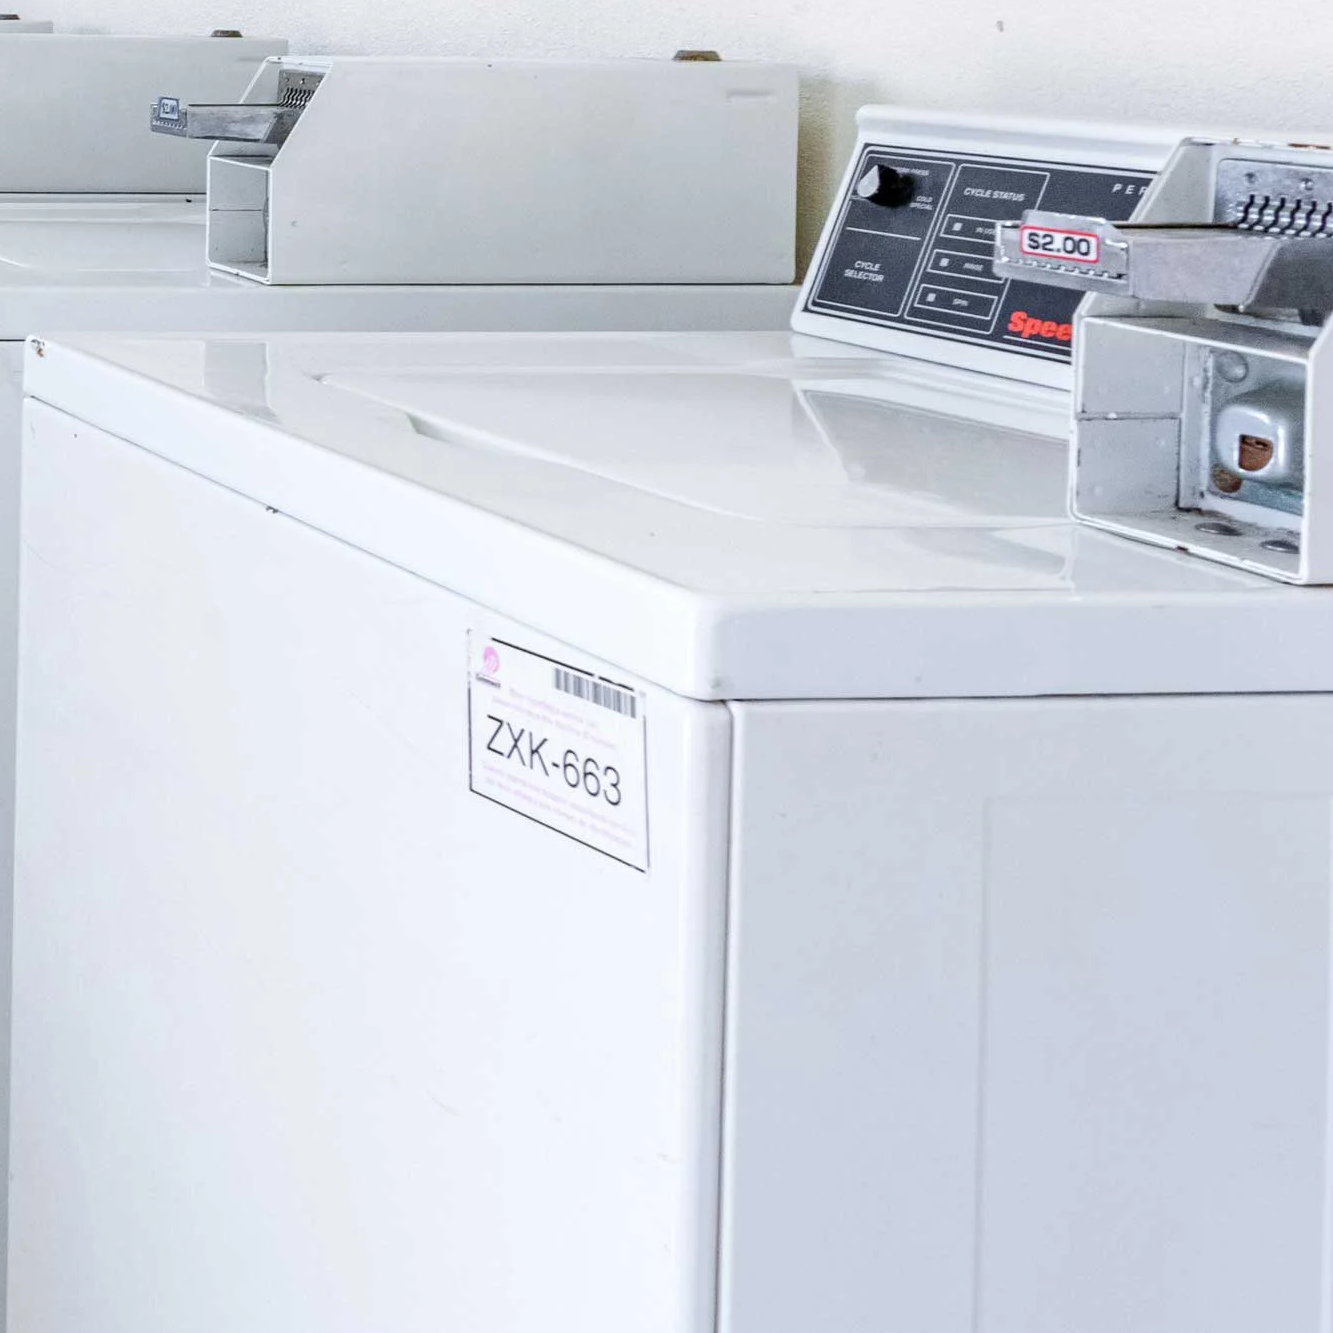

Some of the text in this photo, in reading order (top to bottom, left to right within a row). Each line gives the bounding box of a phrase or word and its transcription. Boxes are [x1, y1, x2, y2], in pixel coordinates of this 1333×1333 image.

[916, 195, 933, 203] COLD
[963, 187, 1025, 202] CYCLE STATUS
[854, 260, 881, 271] CYCLE
[844, 269, 885, 283] SELECTOR
[486, 714, 621, 806] ZXK-663
